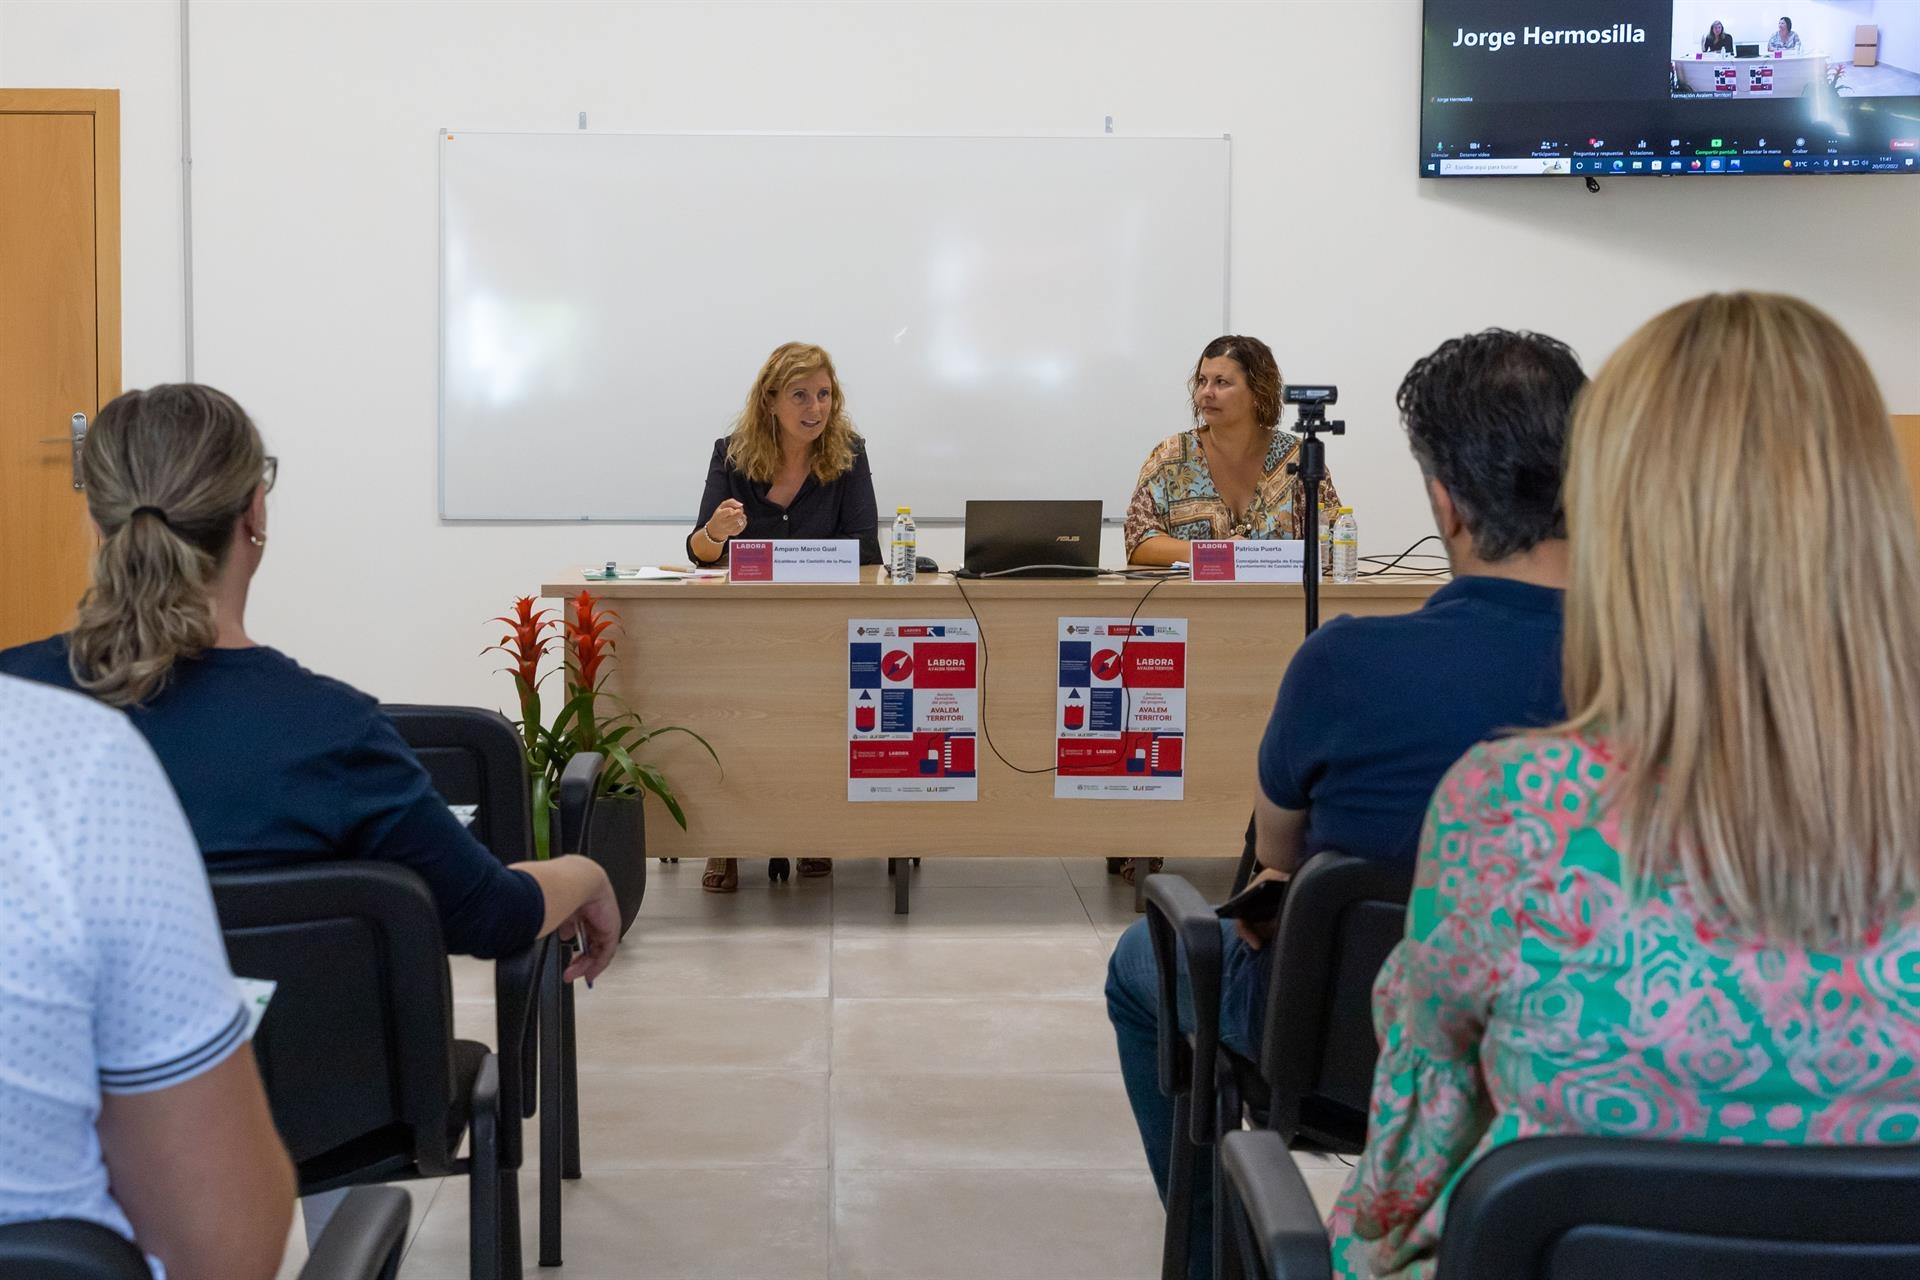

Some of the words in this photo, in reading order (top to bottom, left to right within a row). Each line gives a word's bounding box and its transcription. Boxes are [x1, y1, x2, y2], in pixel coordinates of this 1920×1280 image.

[1453, 28, 1516, 51] Jorge
[1523, 24, 1646, 45] Hermosilla
[1136, 658, 1174, 666] LABORA
